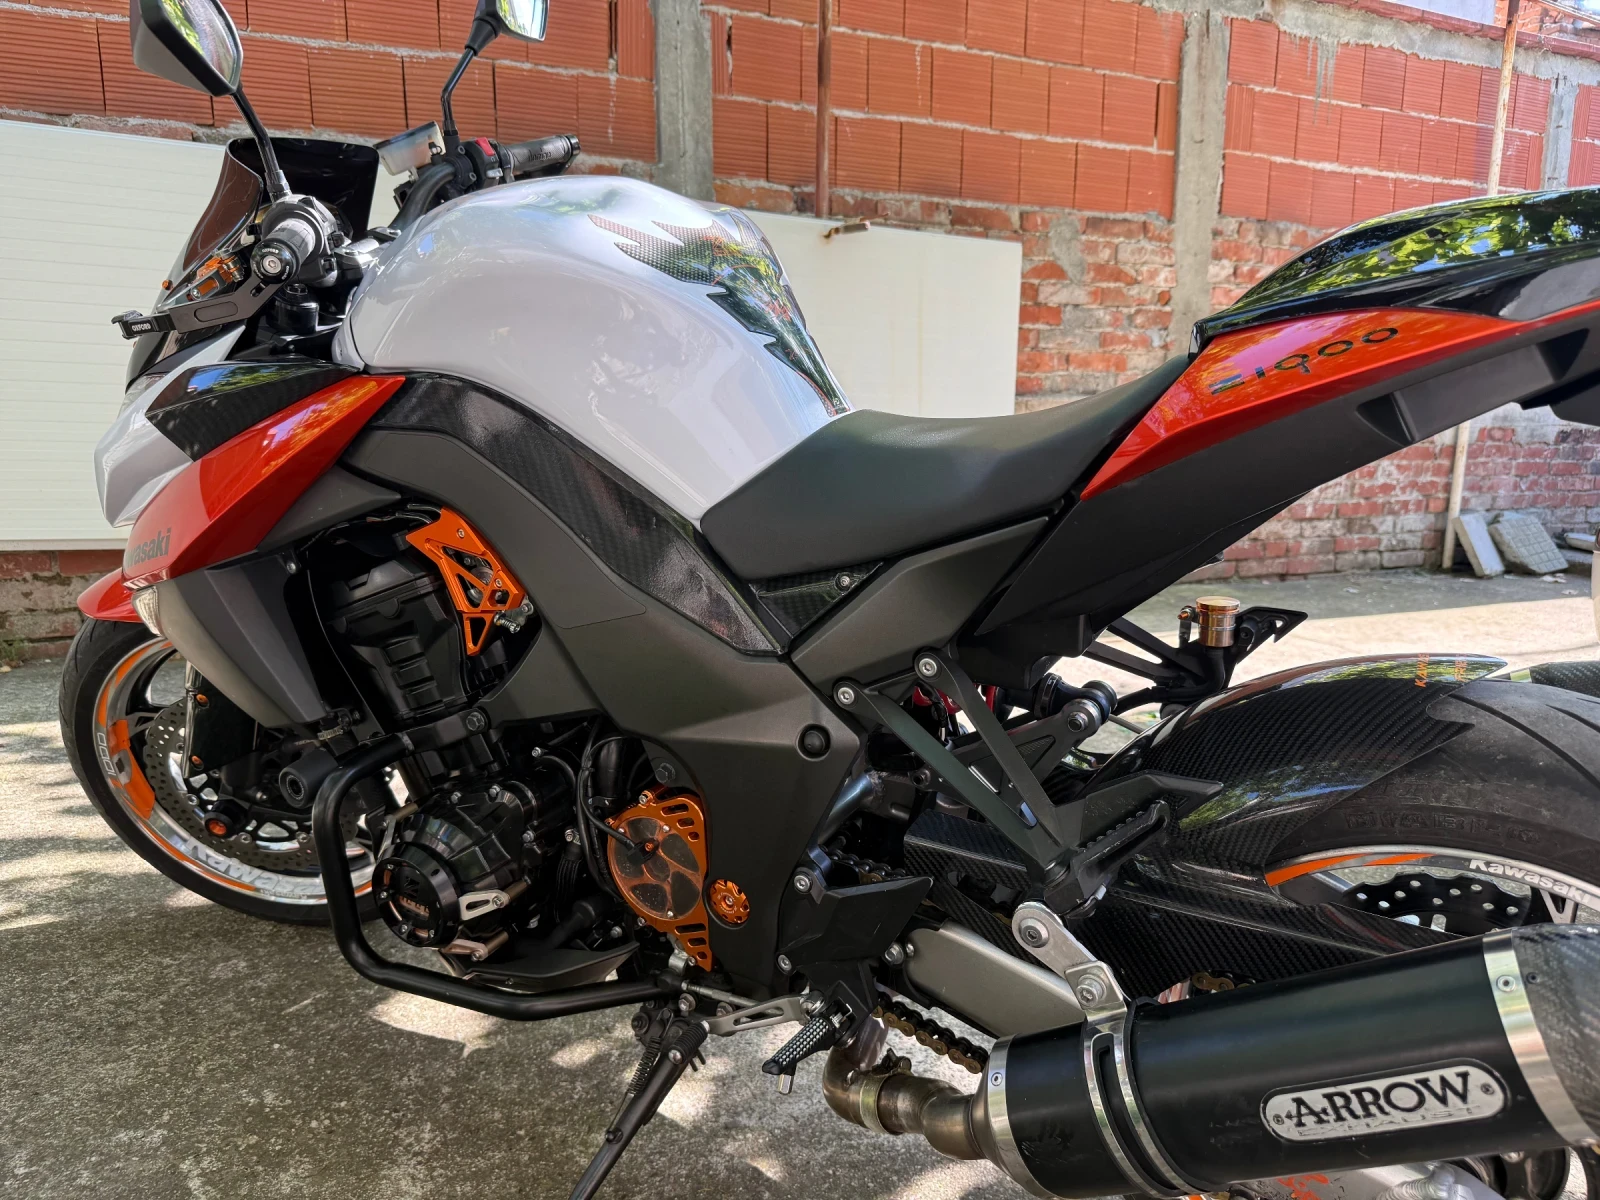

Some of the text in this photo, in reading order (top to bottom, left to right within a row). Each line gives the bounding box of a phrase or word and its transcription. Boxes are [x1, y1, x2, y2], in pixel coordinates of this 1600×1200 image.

[131, 323, 152, 332] OXFORD
[1468, 858, 1592, 904] Kawasaki
[1285, 1070, 1471, 1127] ARROW
